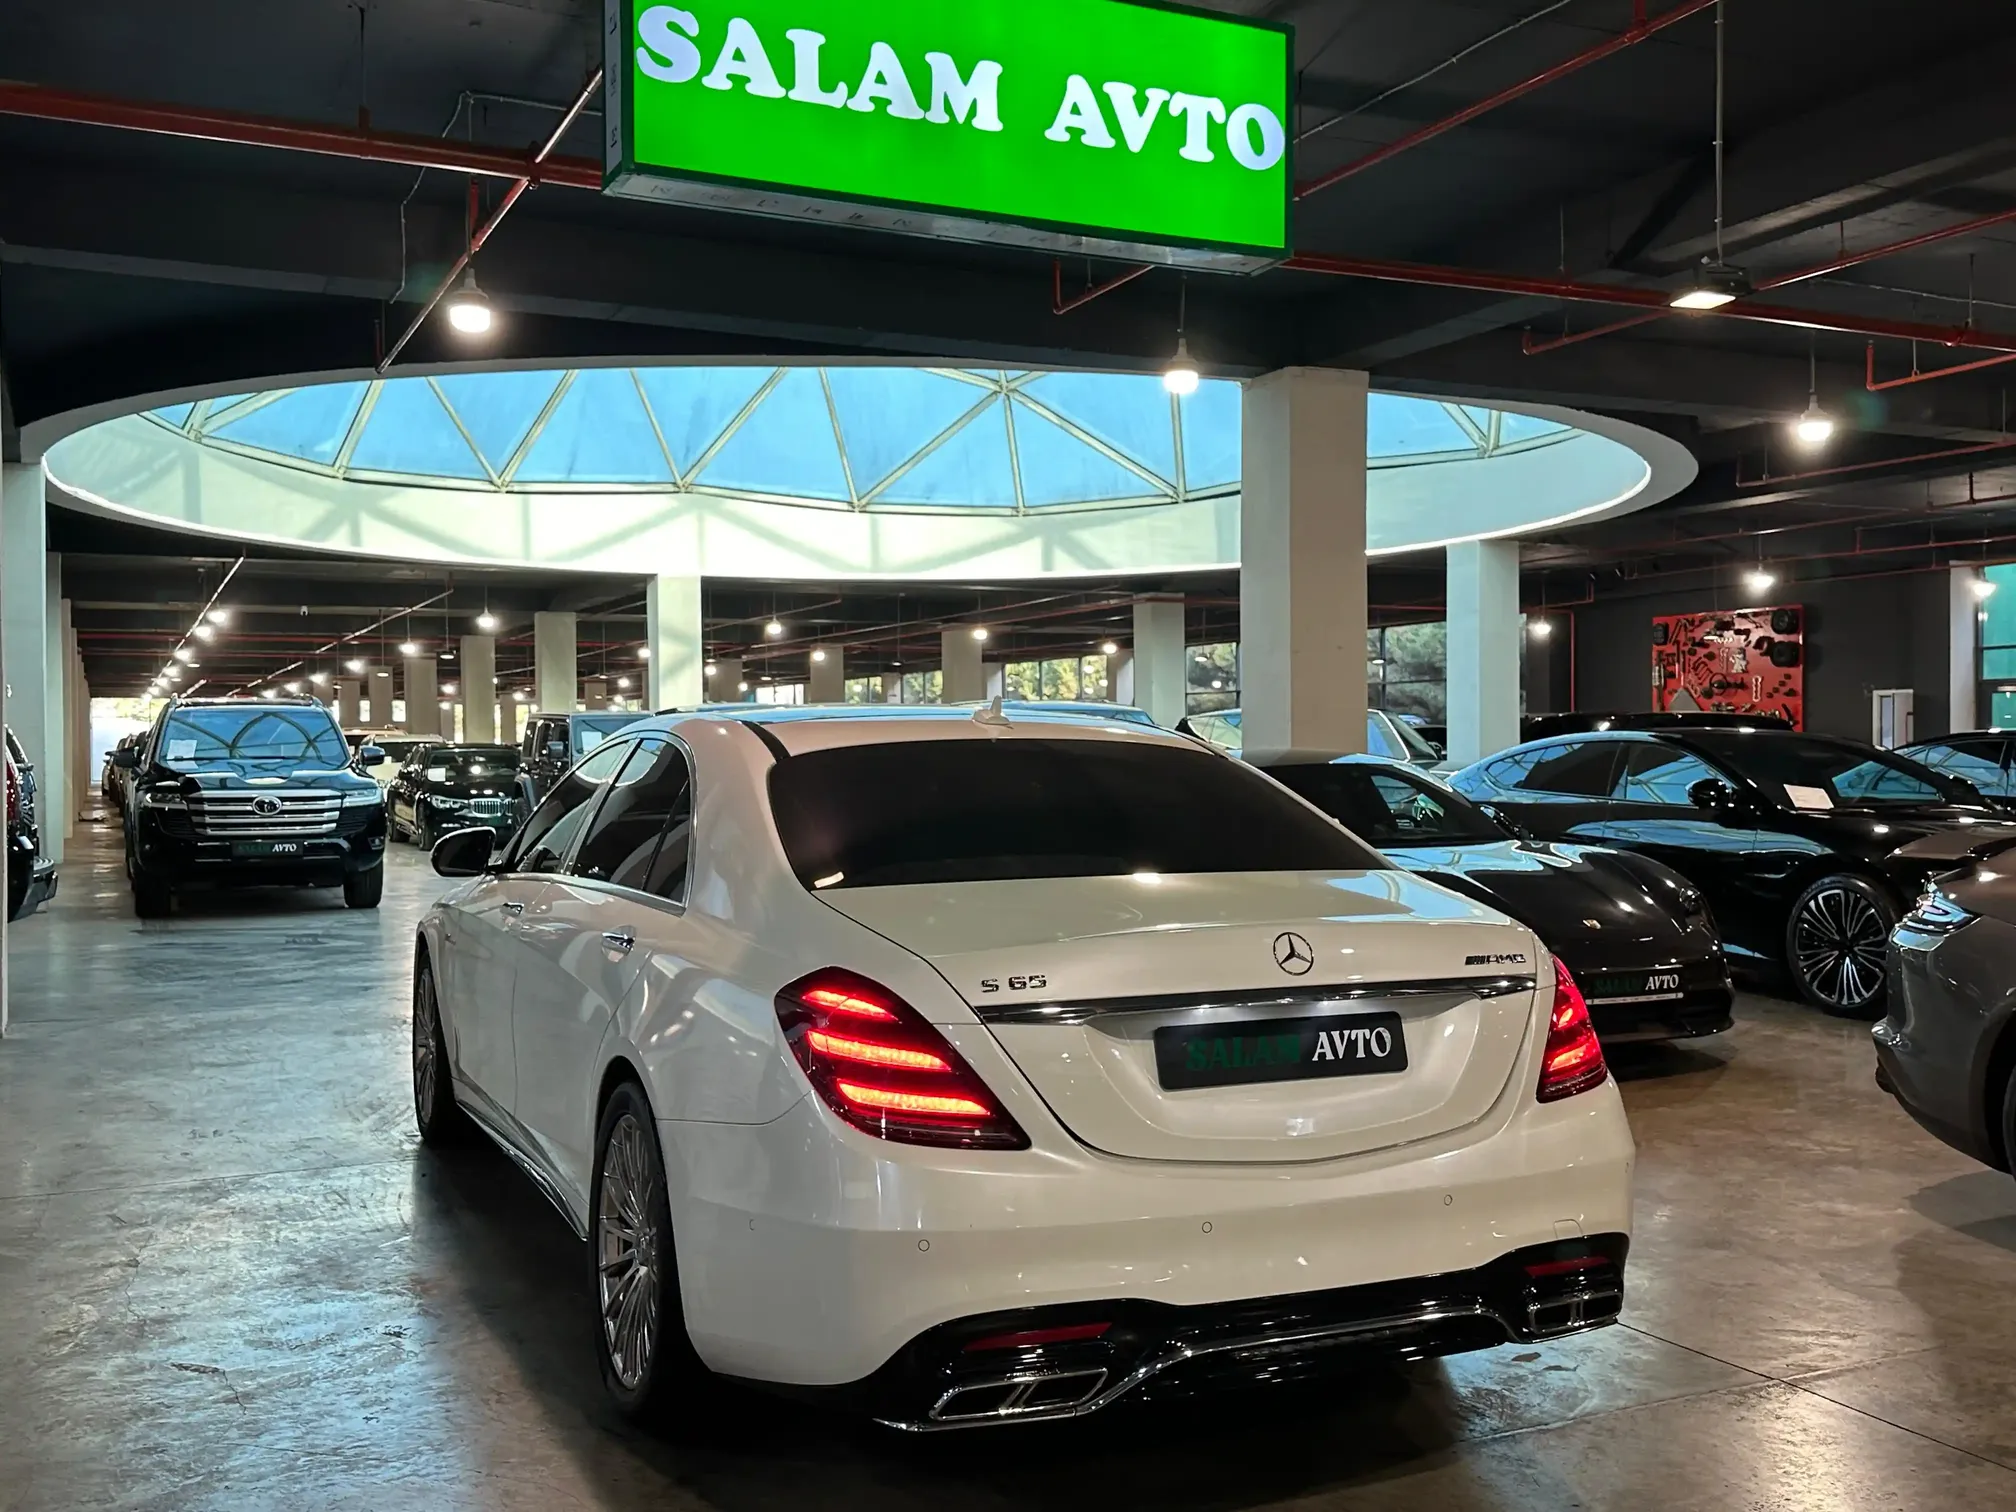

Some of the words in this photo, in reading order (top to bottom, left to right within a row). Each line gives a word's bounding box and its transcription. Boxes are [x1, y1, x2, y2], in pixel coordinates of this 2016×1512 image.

[637, 5, 1004, 132] SALAM
[1045, 74, 1286, 171] AVTO
[272, 843, 297, 853] AVTO
[1486, 953, 1526, 965] AMG
[981, 978, 999, 993] S
[1008, 974, 1047, 991] 65
[1645, 974, 1679, 990] AVTO
[1312, 1026, 1392, 1062] AVTO
